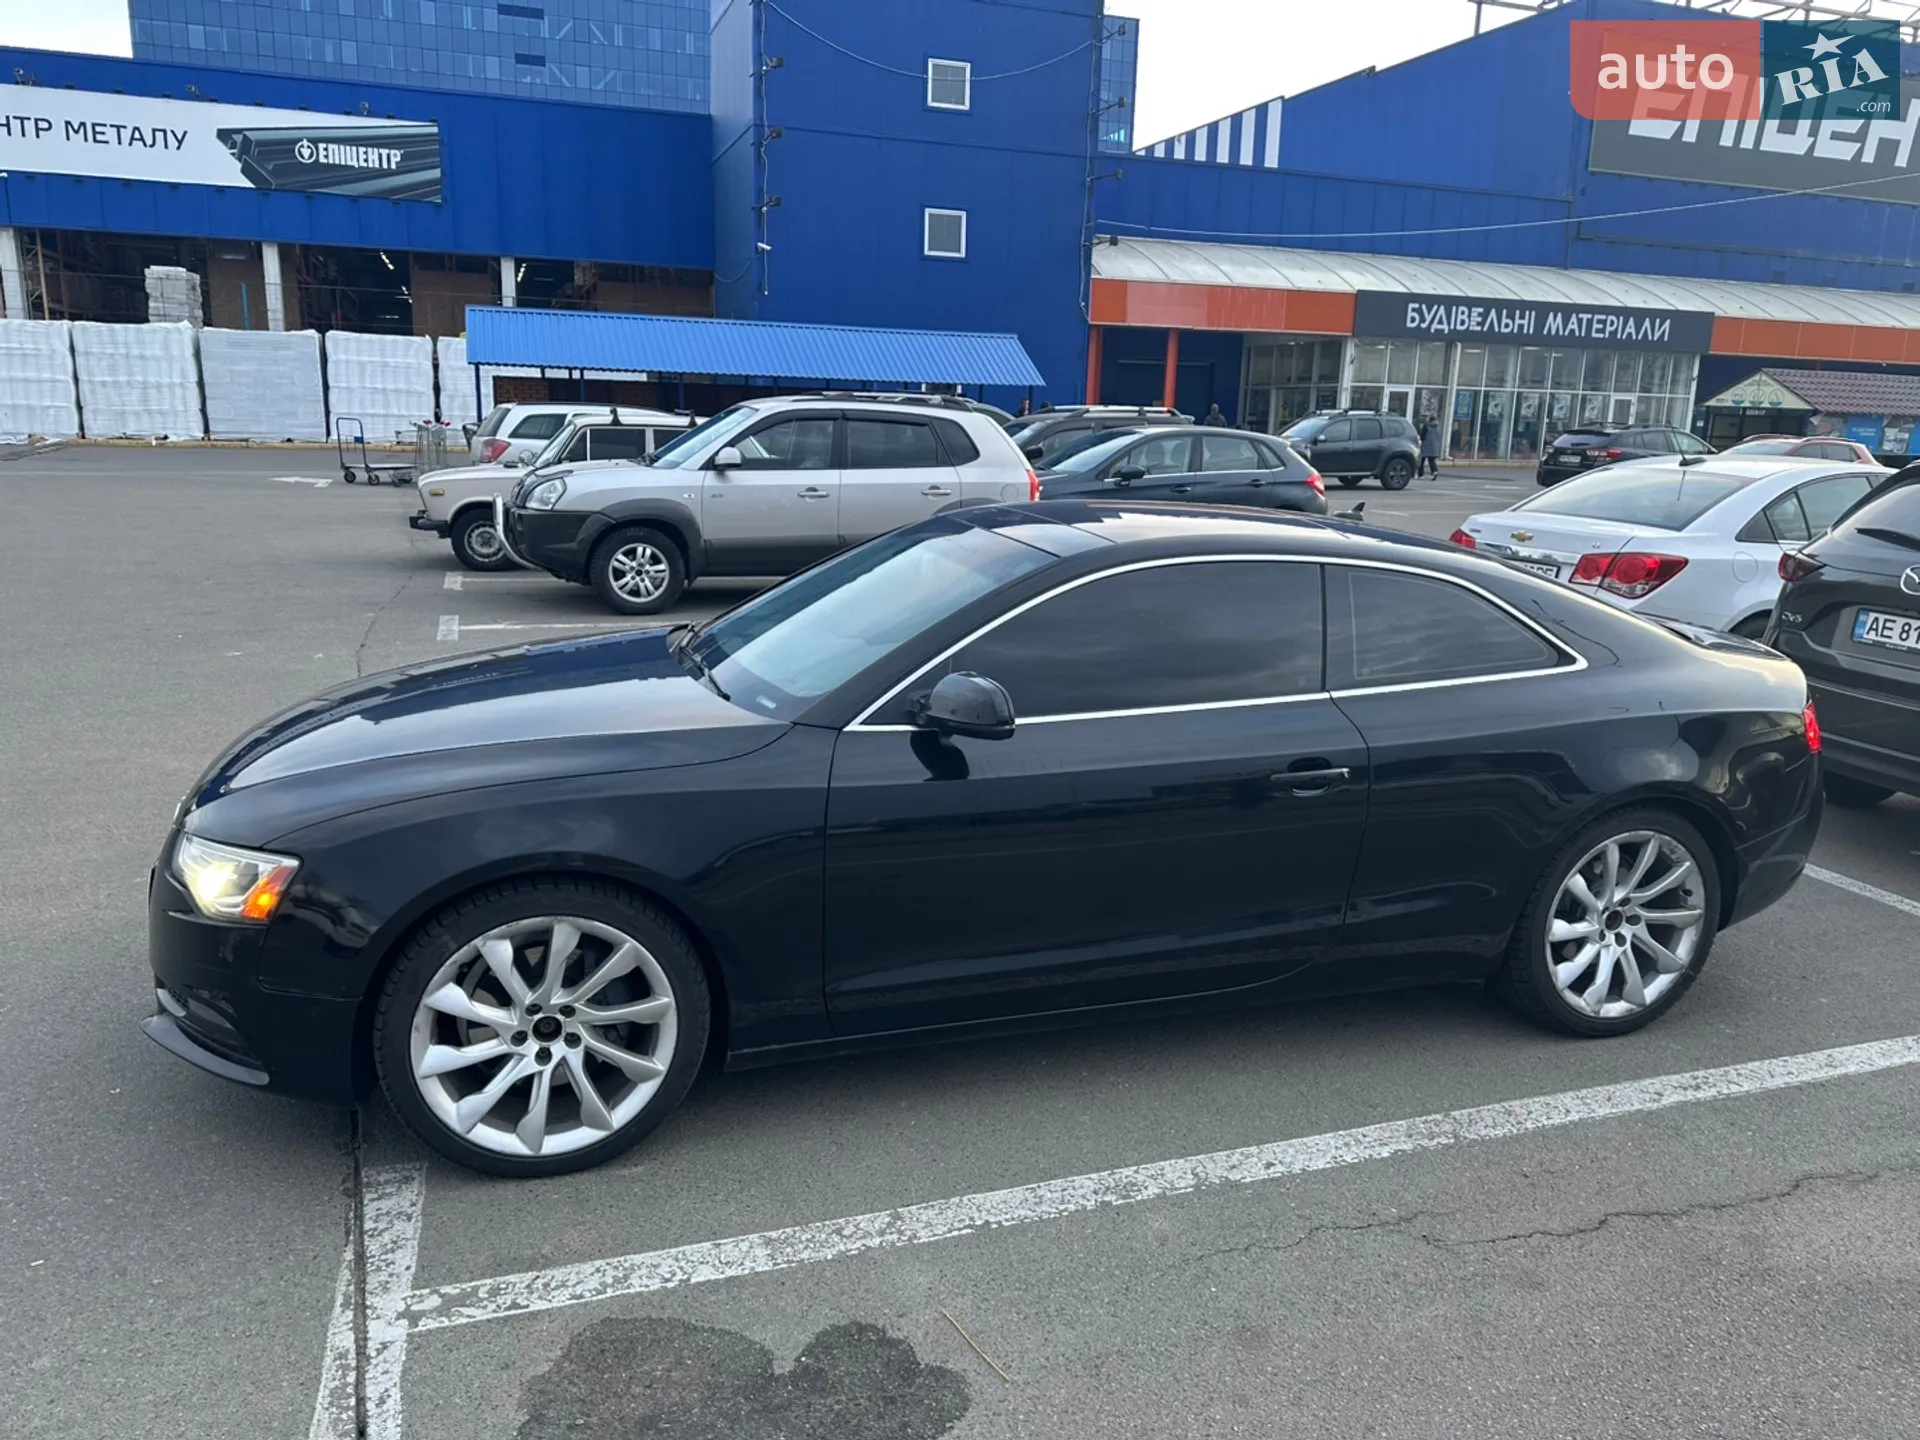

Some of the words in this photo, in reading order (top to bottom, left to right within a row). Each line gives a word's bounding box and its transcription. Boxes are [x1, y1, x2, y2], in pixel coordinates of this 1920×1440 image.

[64, 120, 188, 151] МЕТАЛУ
[317, 142, 402, 170] ЕПІЦЕНТР
[1406, 303, 1536, 335] БУДІВЕЛЬНІ
[1543, 312, 1671, 342] МАТЕРІАЛИ
[1866, 616, 1897, 640] AE
